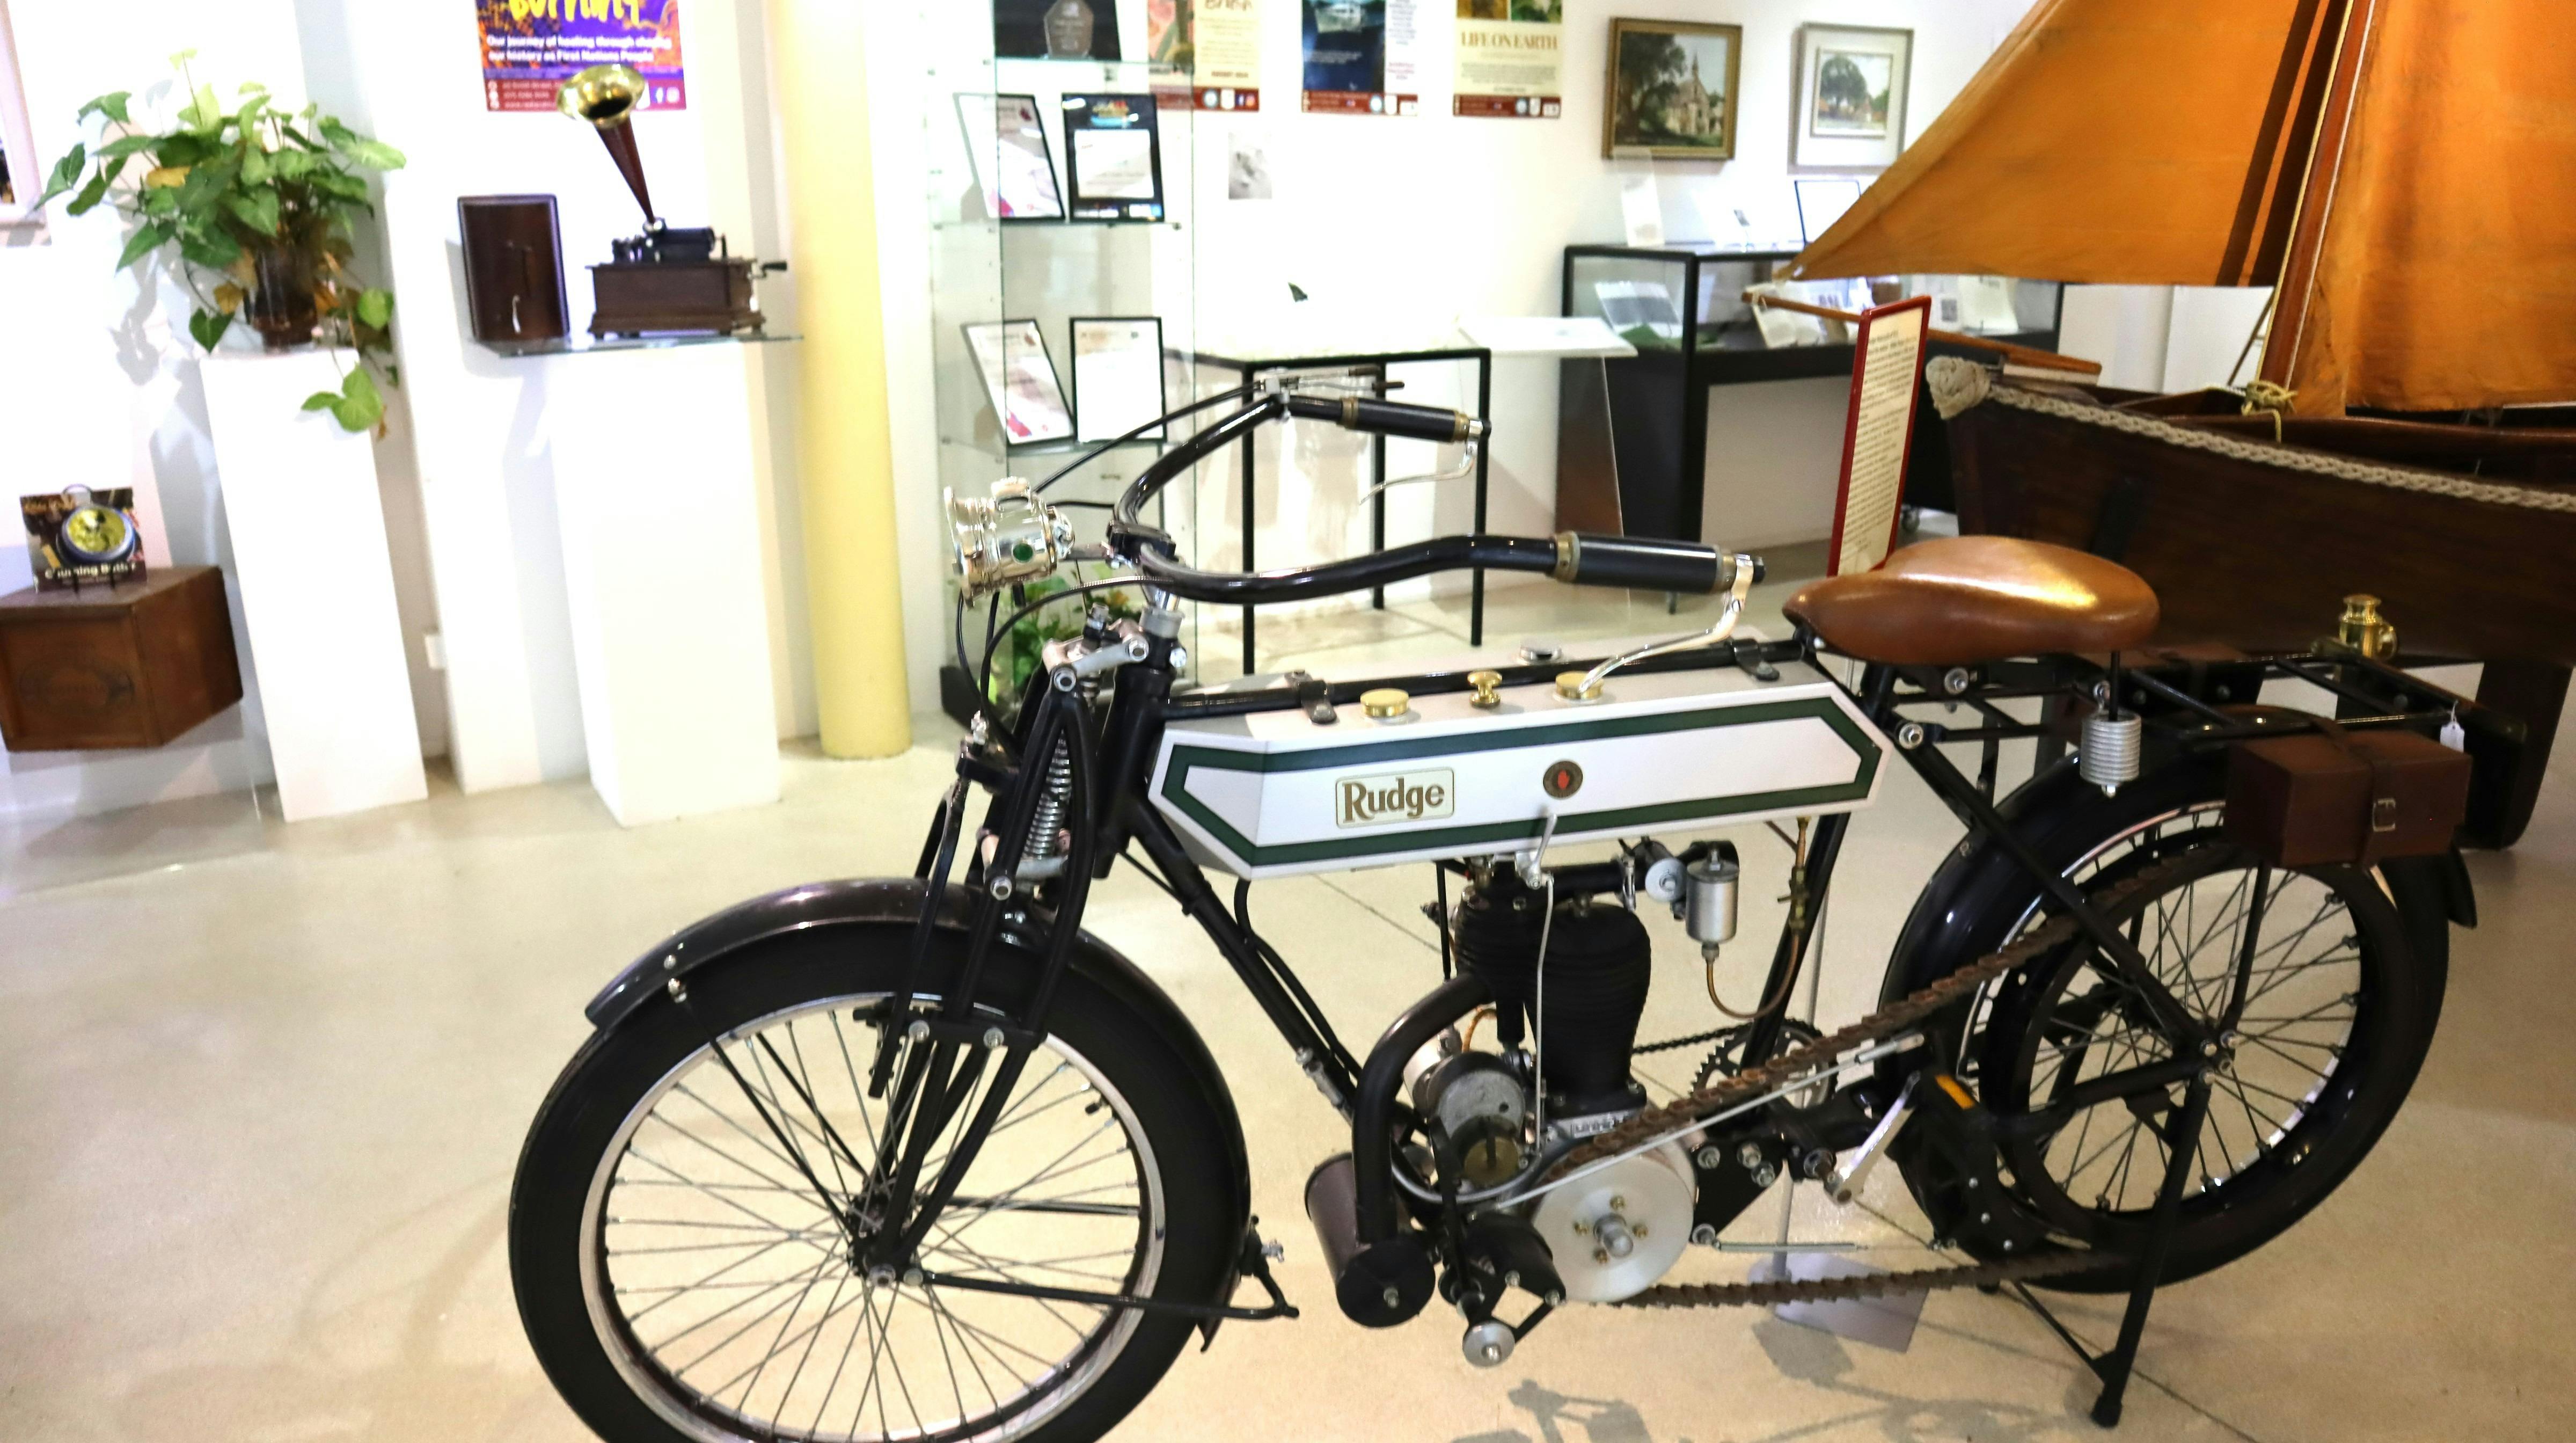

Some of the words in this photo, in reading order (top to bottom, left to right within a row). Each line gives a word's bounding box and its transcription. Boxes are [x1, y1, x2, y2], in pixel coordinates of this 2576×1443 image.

[1461, 31, 1488, 48] LIFE
[1491, 32, 1511, 49] ON
[1512, 33, 1558, 50] EARTH
[1343, 776, 1445, 823] Rudge
